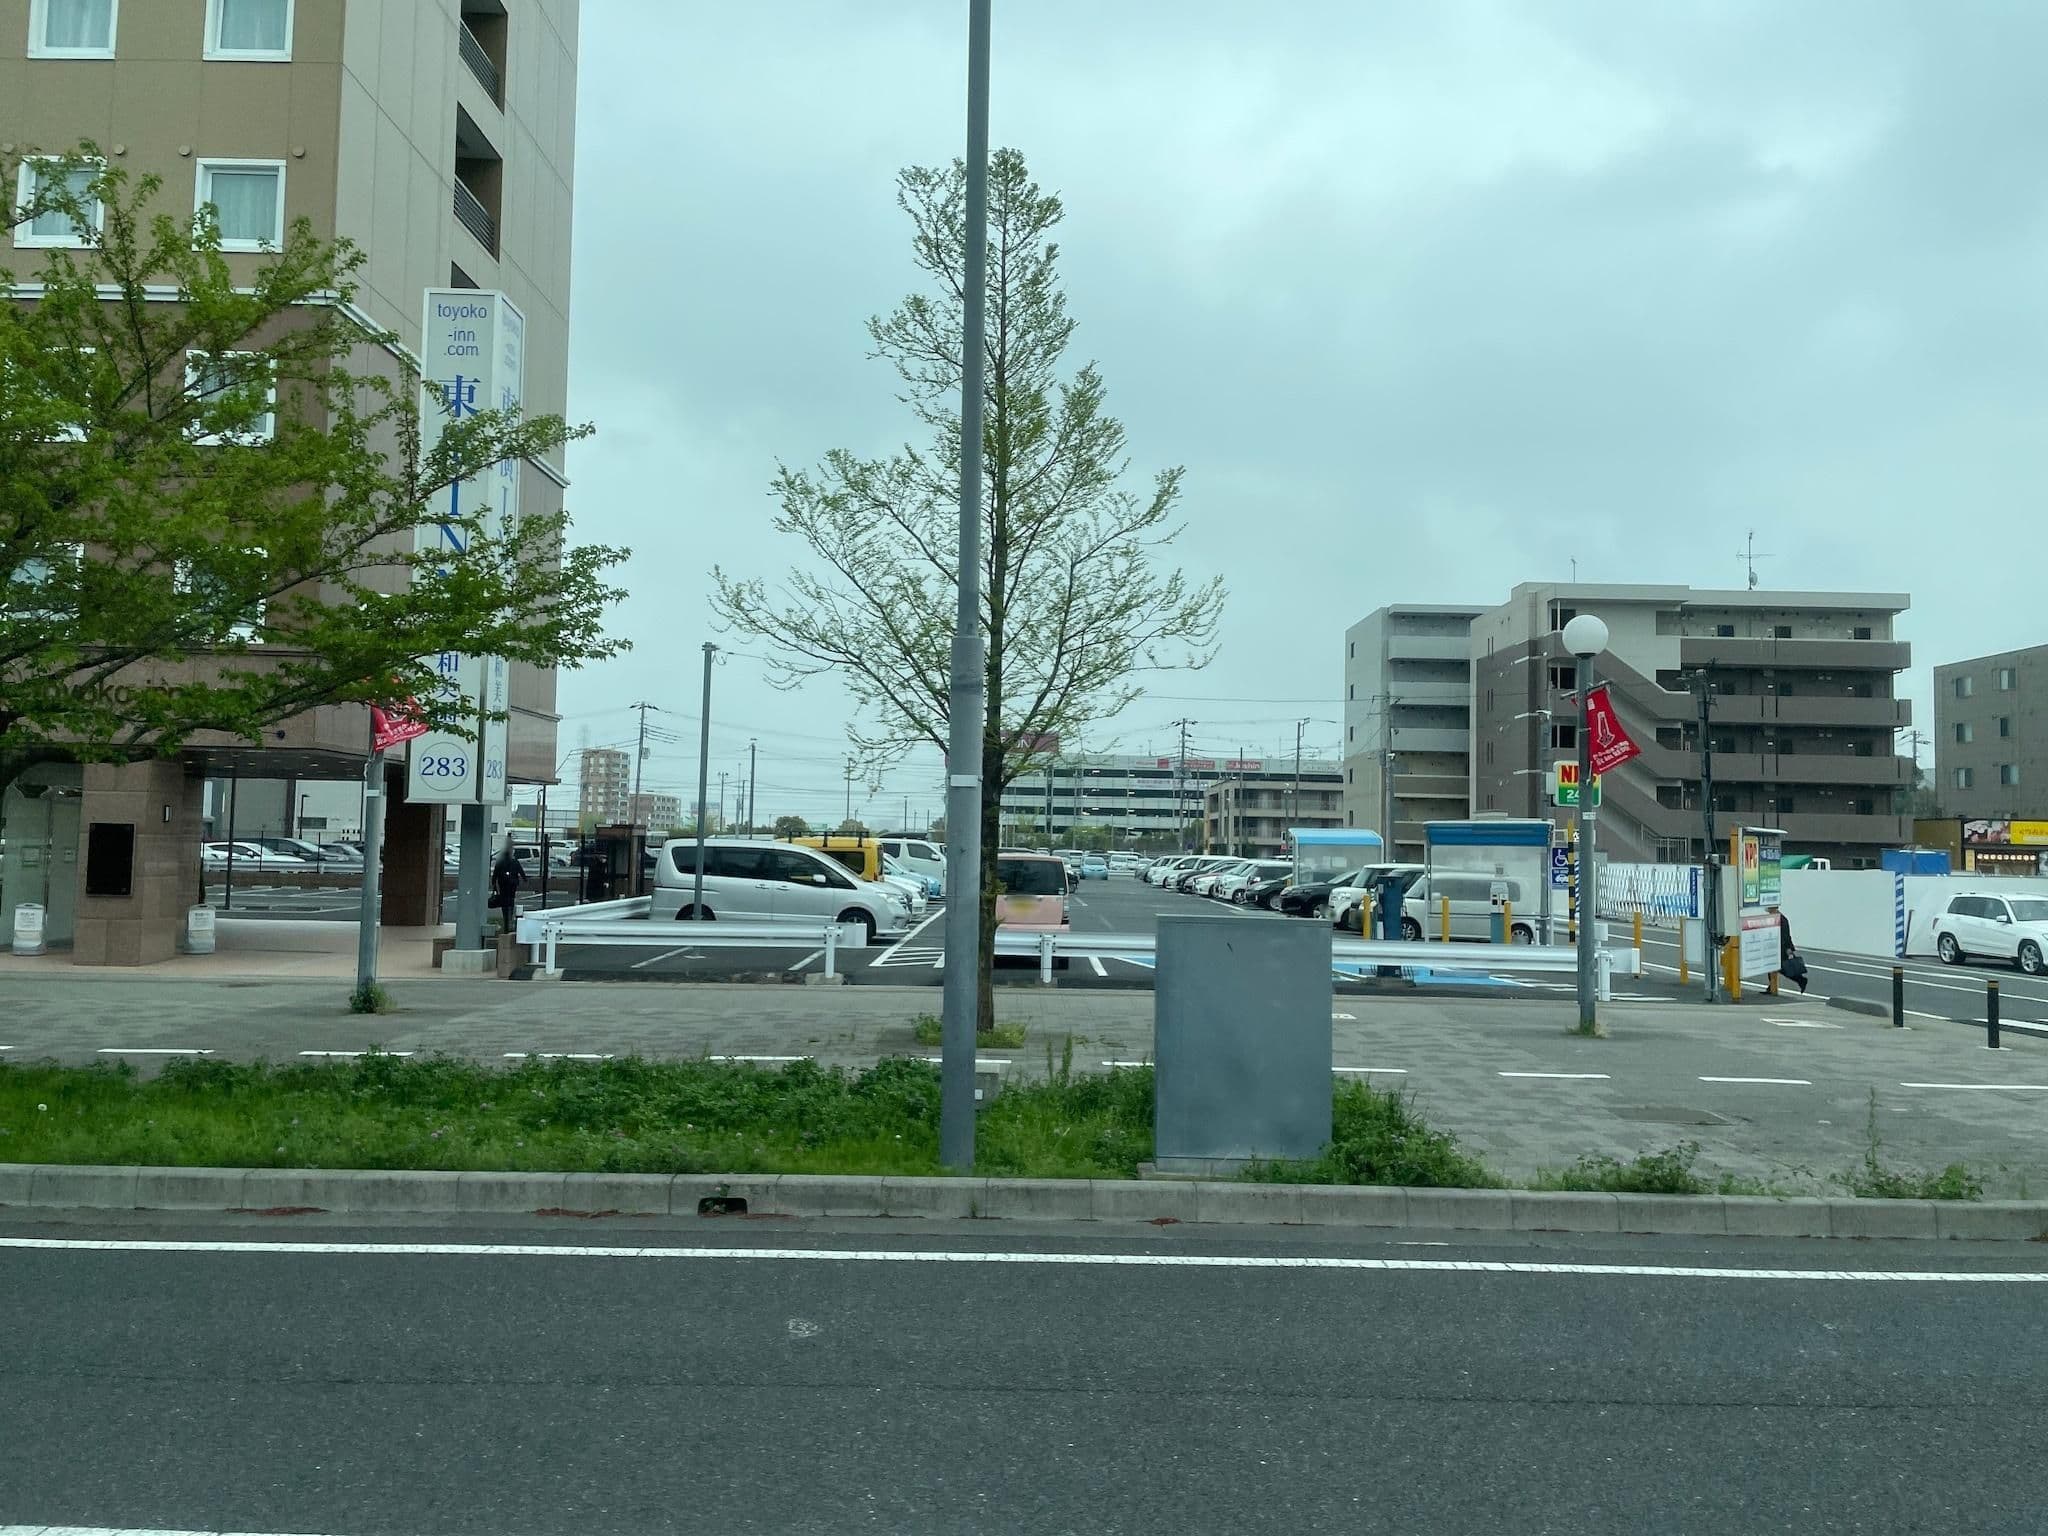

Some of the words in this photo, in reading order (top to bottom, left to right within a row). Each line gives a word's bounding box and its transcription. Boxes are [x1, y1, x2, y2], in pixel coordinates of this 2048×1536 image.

[437, 303, 488, 322] toyoko
[447, 326, 476, 342] -inn
[443, 344, 480, 357] .com
[420, 755, 466, 777] 283
[486, 758, 503, 778] 283
